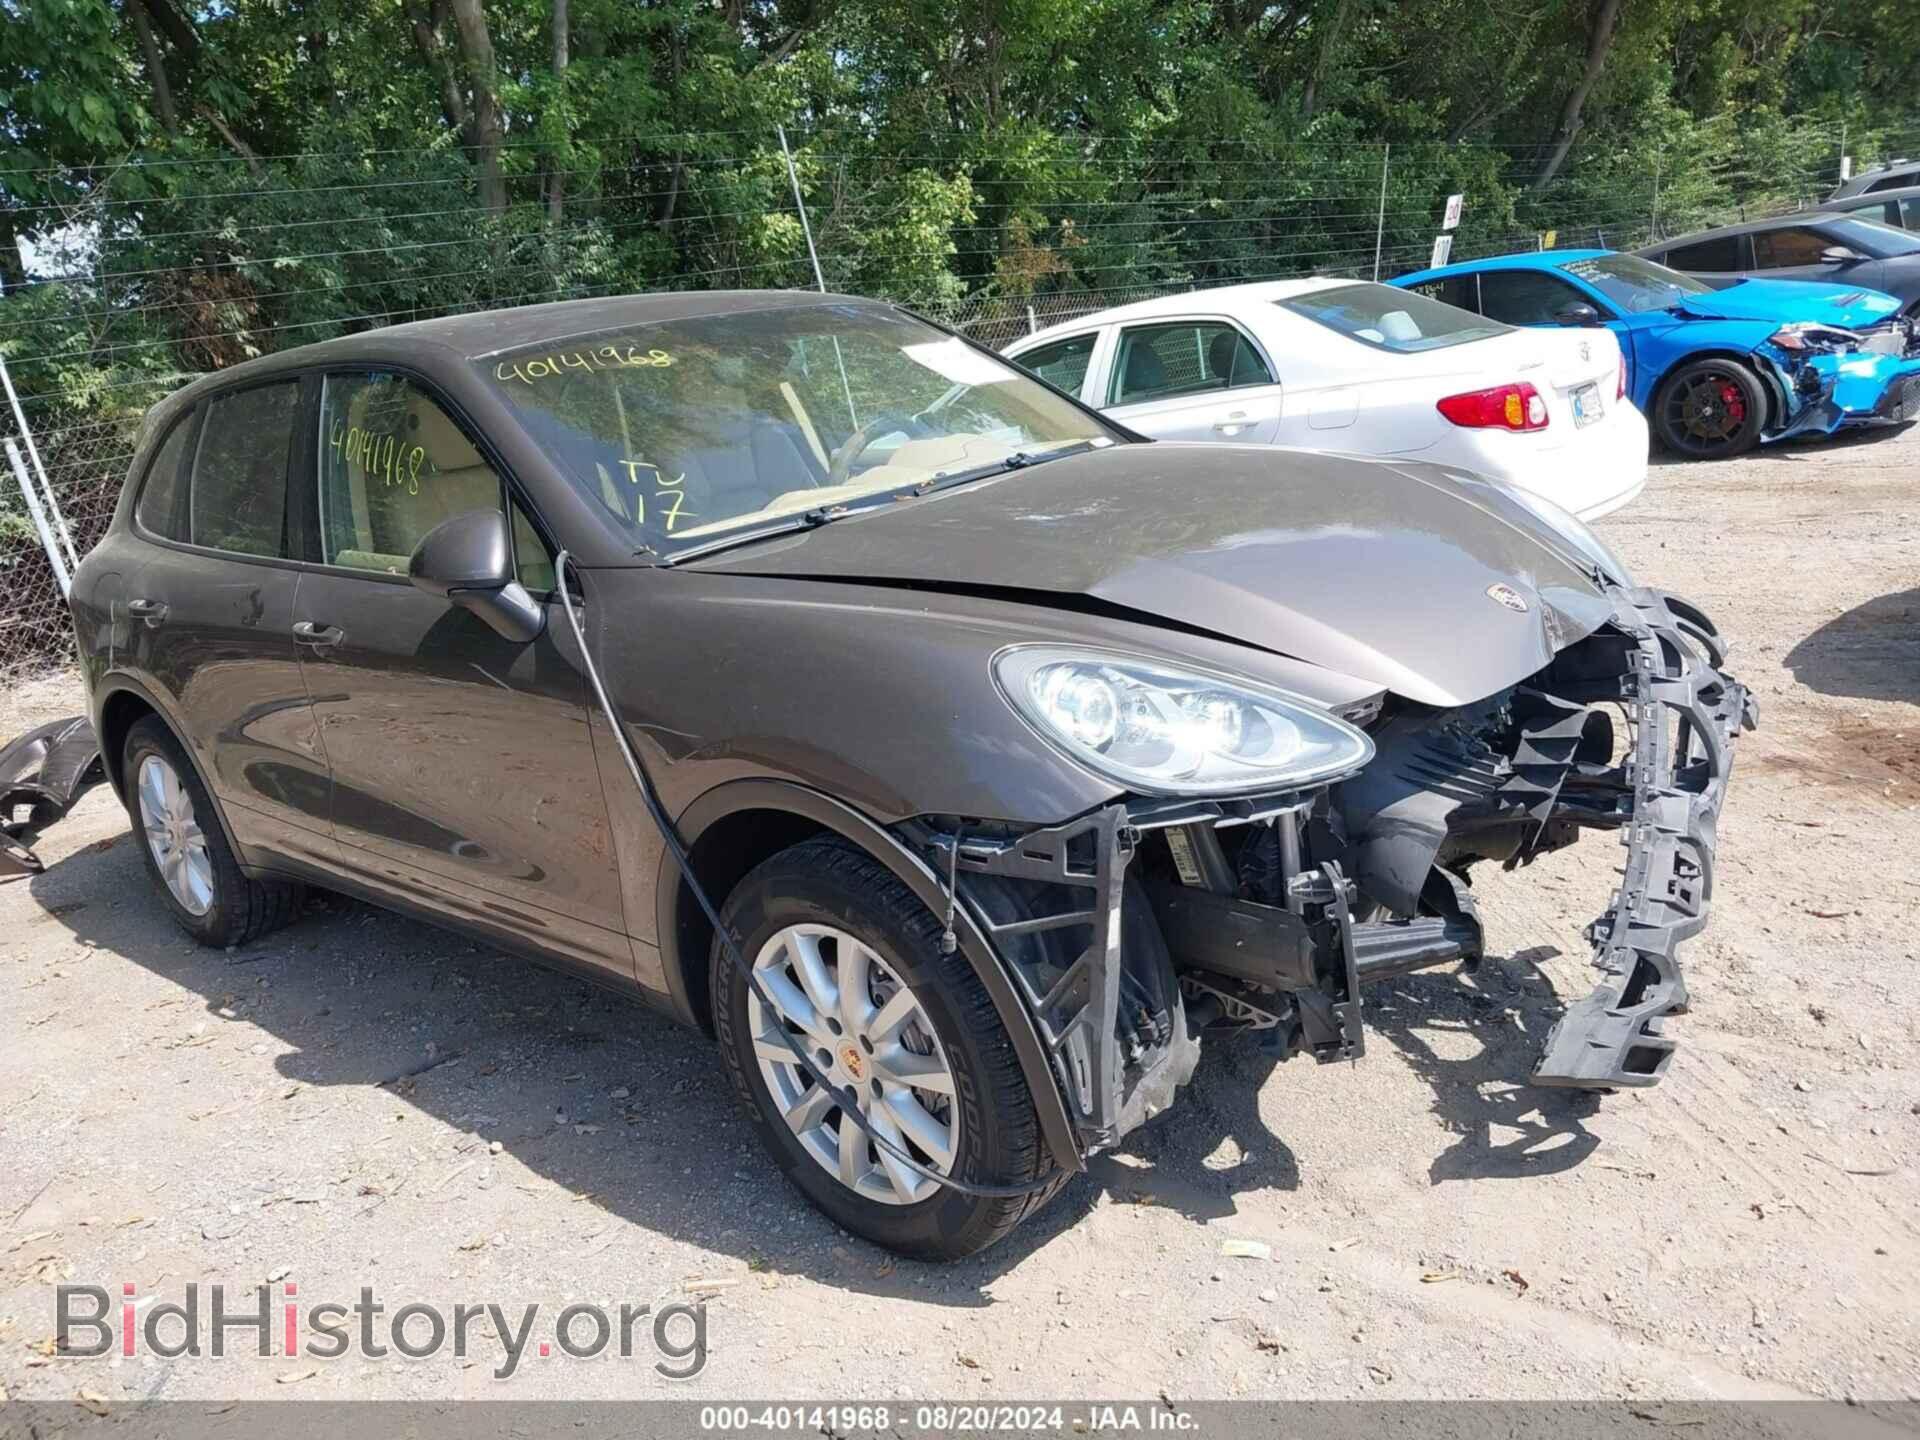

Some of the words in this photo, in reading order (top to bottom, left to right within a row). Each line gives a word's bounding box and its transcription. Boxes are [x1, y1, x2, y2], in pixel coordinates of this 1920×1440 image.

[497, 347, 672, 384] 40141968
[330, 418, 424, 495] 40141968
[637, 490, 698, 530] 17
